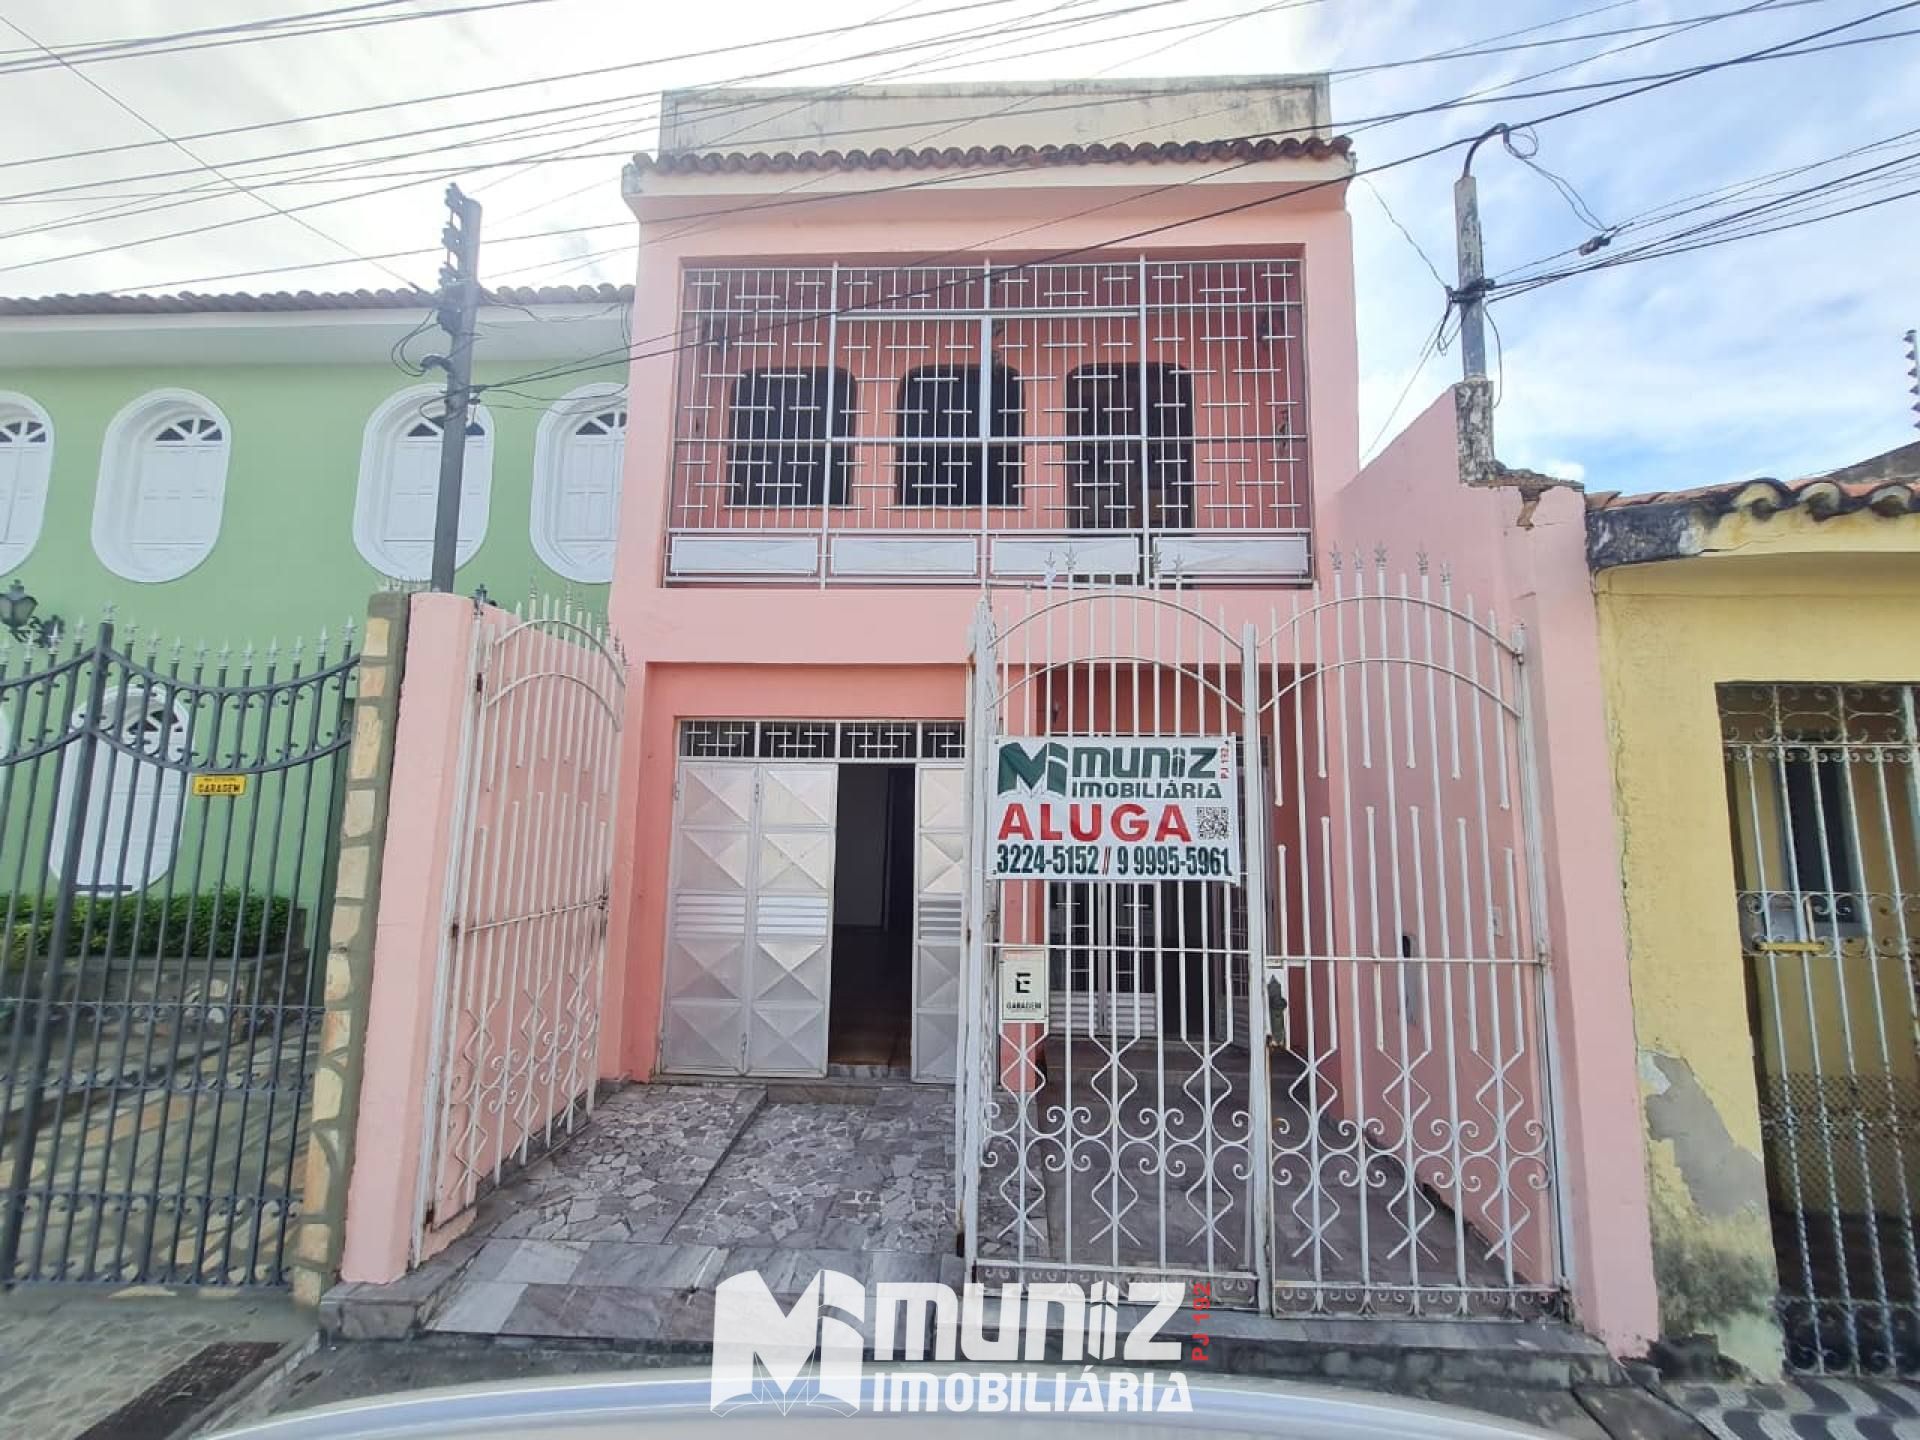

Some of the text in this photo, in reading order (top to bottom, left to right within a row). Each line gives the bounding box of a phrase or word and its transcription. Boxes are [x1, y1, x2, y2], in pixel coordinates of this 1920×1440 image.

[1072, 780, 1222, 799] IMOBILIÁRIA
[998, 803, 1192, 842] ALUGA
[997, 844, 1099, 875] 3224-5152
[1133, 847, 1231, 877] 9995-5961
